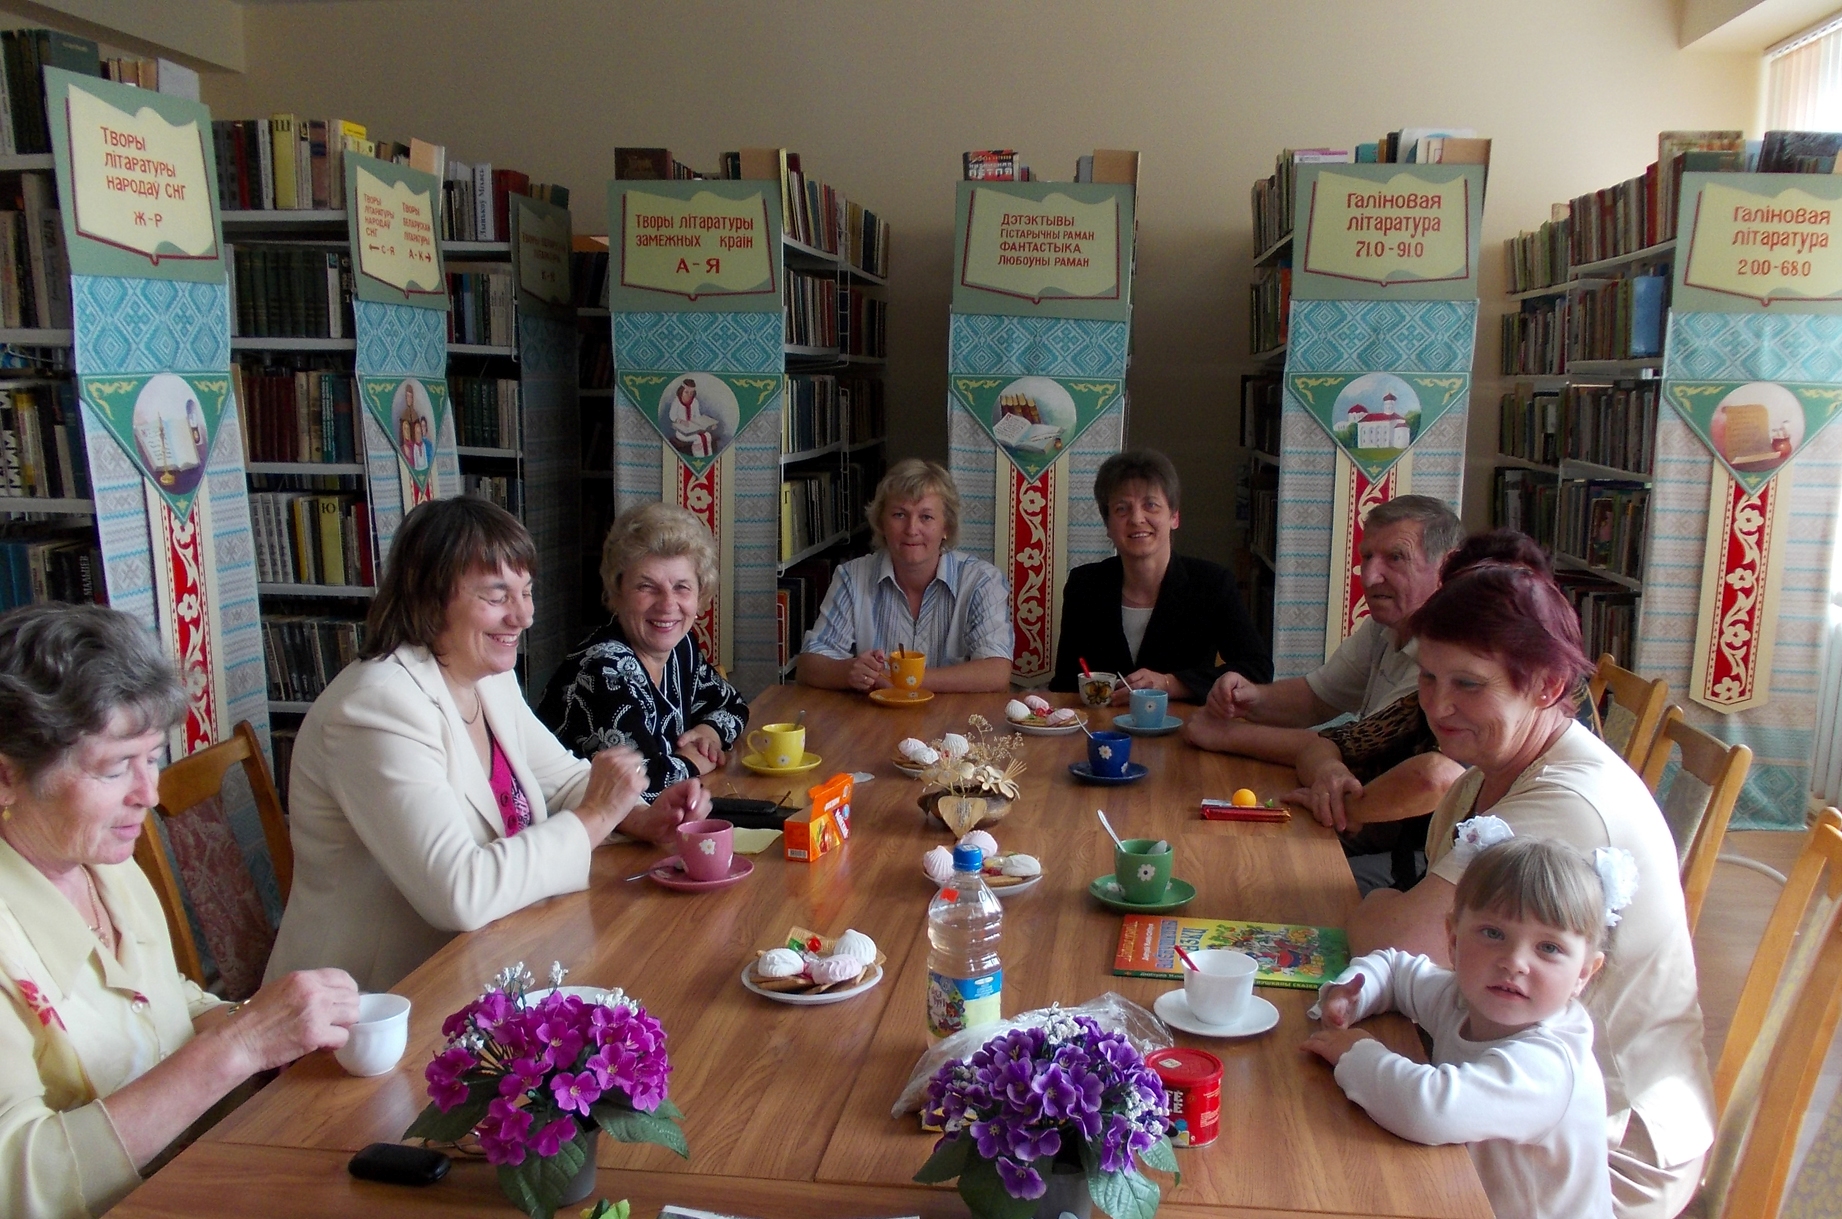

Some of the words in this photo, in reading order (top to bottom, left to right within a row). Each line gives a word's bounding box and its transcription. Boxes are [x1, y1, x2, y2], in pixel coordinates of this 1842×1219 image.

[105, 150, 176, 178] літаратуры
[106, 175, 160, 200] народаў
[165, 183, 186, 200] СНГ
[679, 213, 753, 232] літаратуры
[1001, 214, 1074, 227] ДЭТЭКТЫВЫ
[1346, 213, 1441, 238] літаратура
[366, 227, 378, 237] СНГ
[1000, 229, 1060, 240] ГІСТАРЫЧНЫ
[1063, 231, 1095, 240] РАМАН
[719, 234, 753, 251] краін
[1000, 241, 1082, 254] ФАНТАСТЫКА
[1732, 228, 1829, 254] літаратура
[998, 254, 1050, 268] ЛЮБОЎНЫ
[1054, 258, 1089, 267] РАМАН
[322, 503, 335, 514] Ю
